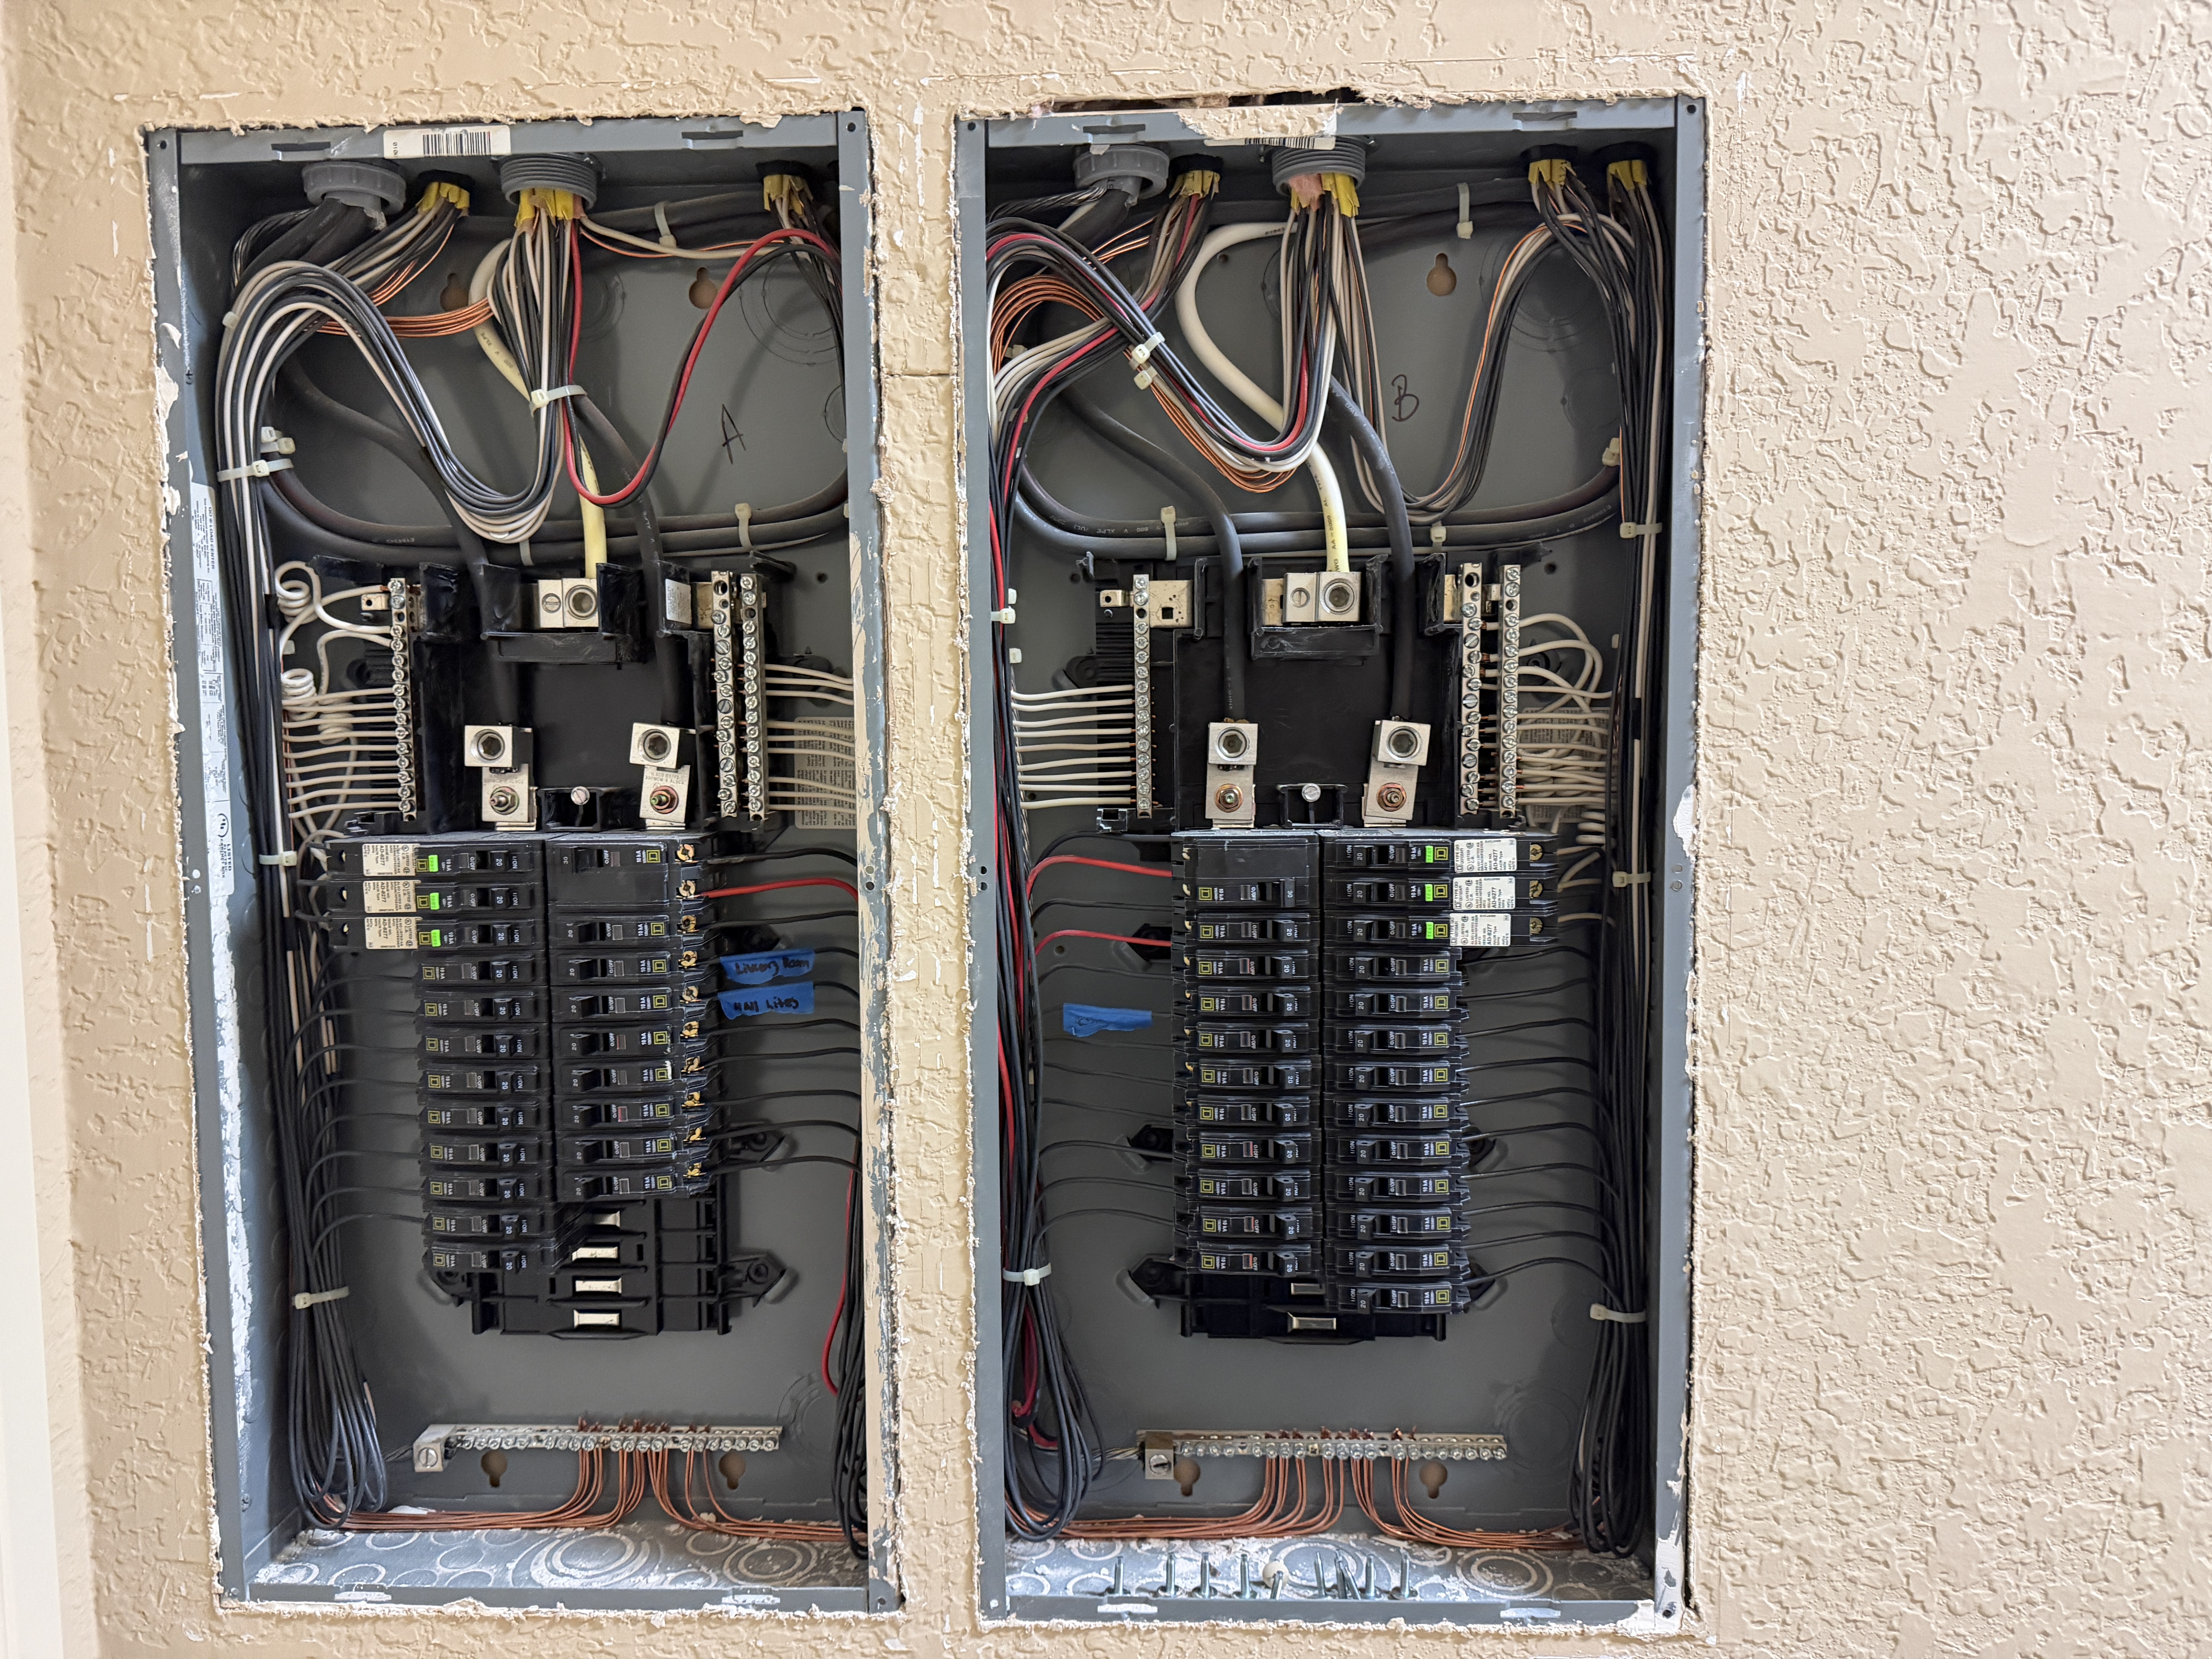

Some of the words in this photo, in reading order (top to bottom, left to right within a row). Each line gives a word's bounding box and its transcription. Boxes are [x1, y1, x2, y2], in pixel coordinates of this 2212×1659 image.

[1391, 374, 1419, 422] B
[722, 404, 746, 464] A
[500, 1007, 505, 1015] 20
[1286, 1188, 1291, 1196] 20
